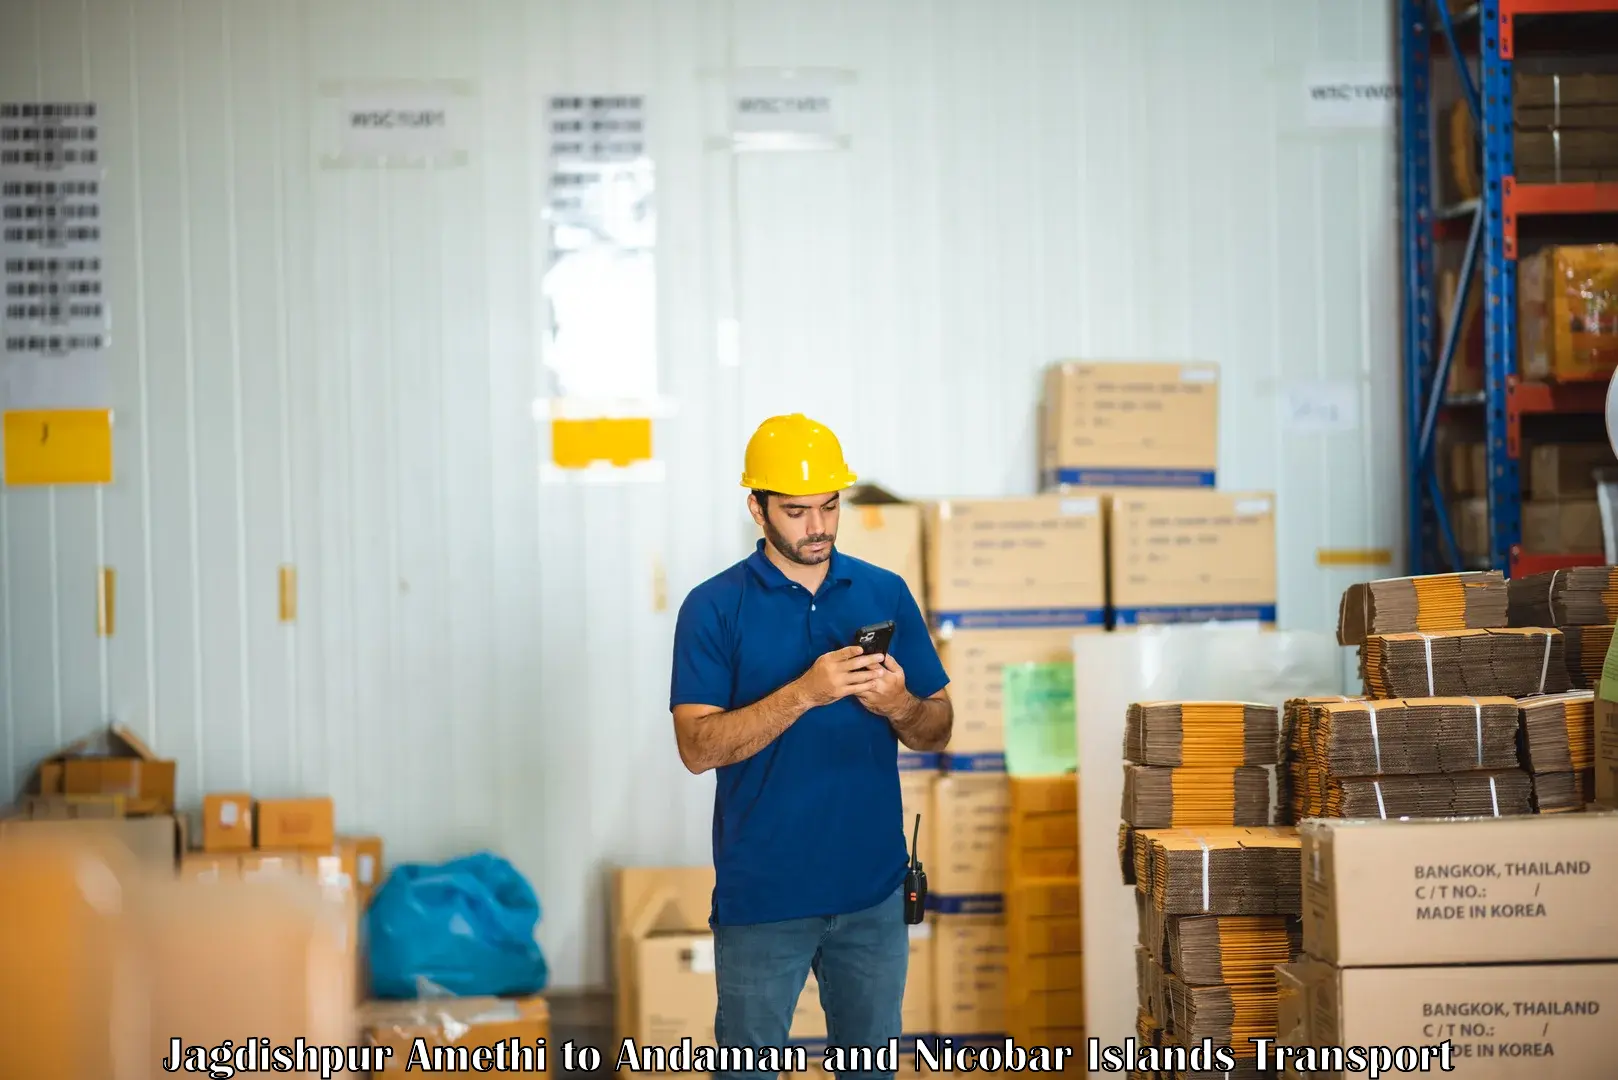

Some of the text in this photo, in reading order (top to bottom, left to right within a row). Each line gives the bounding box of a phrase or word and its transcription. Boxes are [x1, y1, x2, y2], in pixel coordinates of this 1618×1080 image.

[1414, 861, 1591, 880] BANGKOK, THAILAND
[1416, 903, 1547, 920] MADE IN KOREA
[1422, 1001, 1600, 1018] BANGKOK, THAILAND
[1477, 1043, 1494, 1057] IN
[1499, 1042, 1555, 1057] KOREA
